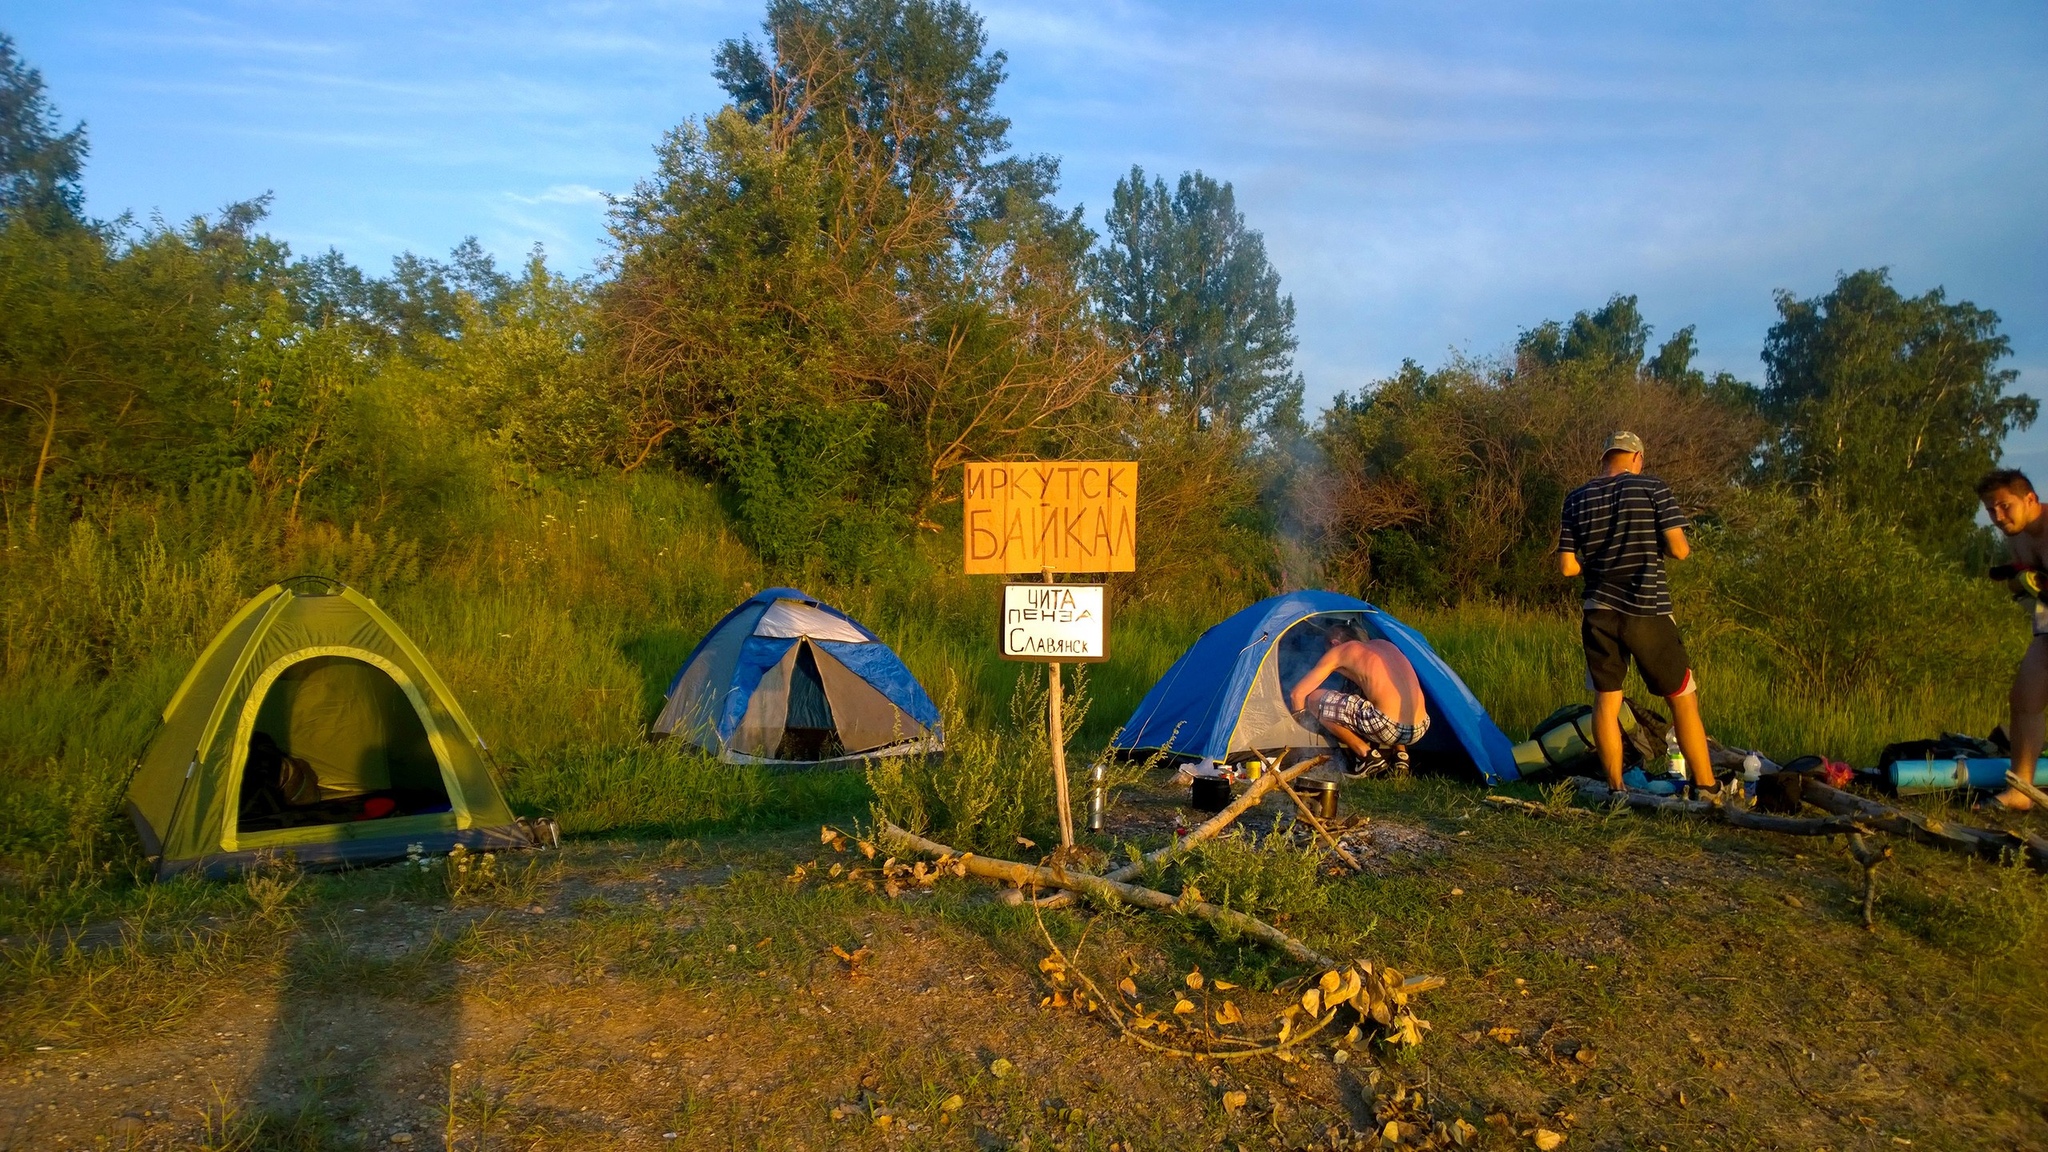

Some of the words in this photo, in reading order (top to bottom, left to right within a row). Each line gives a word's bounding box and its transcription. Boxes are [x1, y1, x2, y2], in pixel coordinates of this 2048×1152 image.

[967, 467, 1128, 500] ИРКУТСК
[970, 503, 1136, 560] БАЙКАЛ
[1028, 589, 1076, 610] ЧИТА
[1008, 608, 1095, 625] ПЕНЗА
